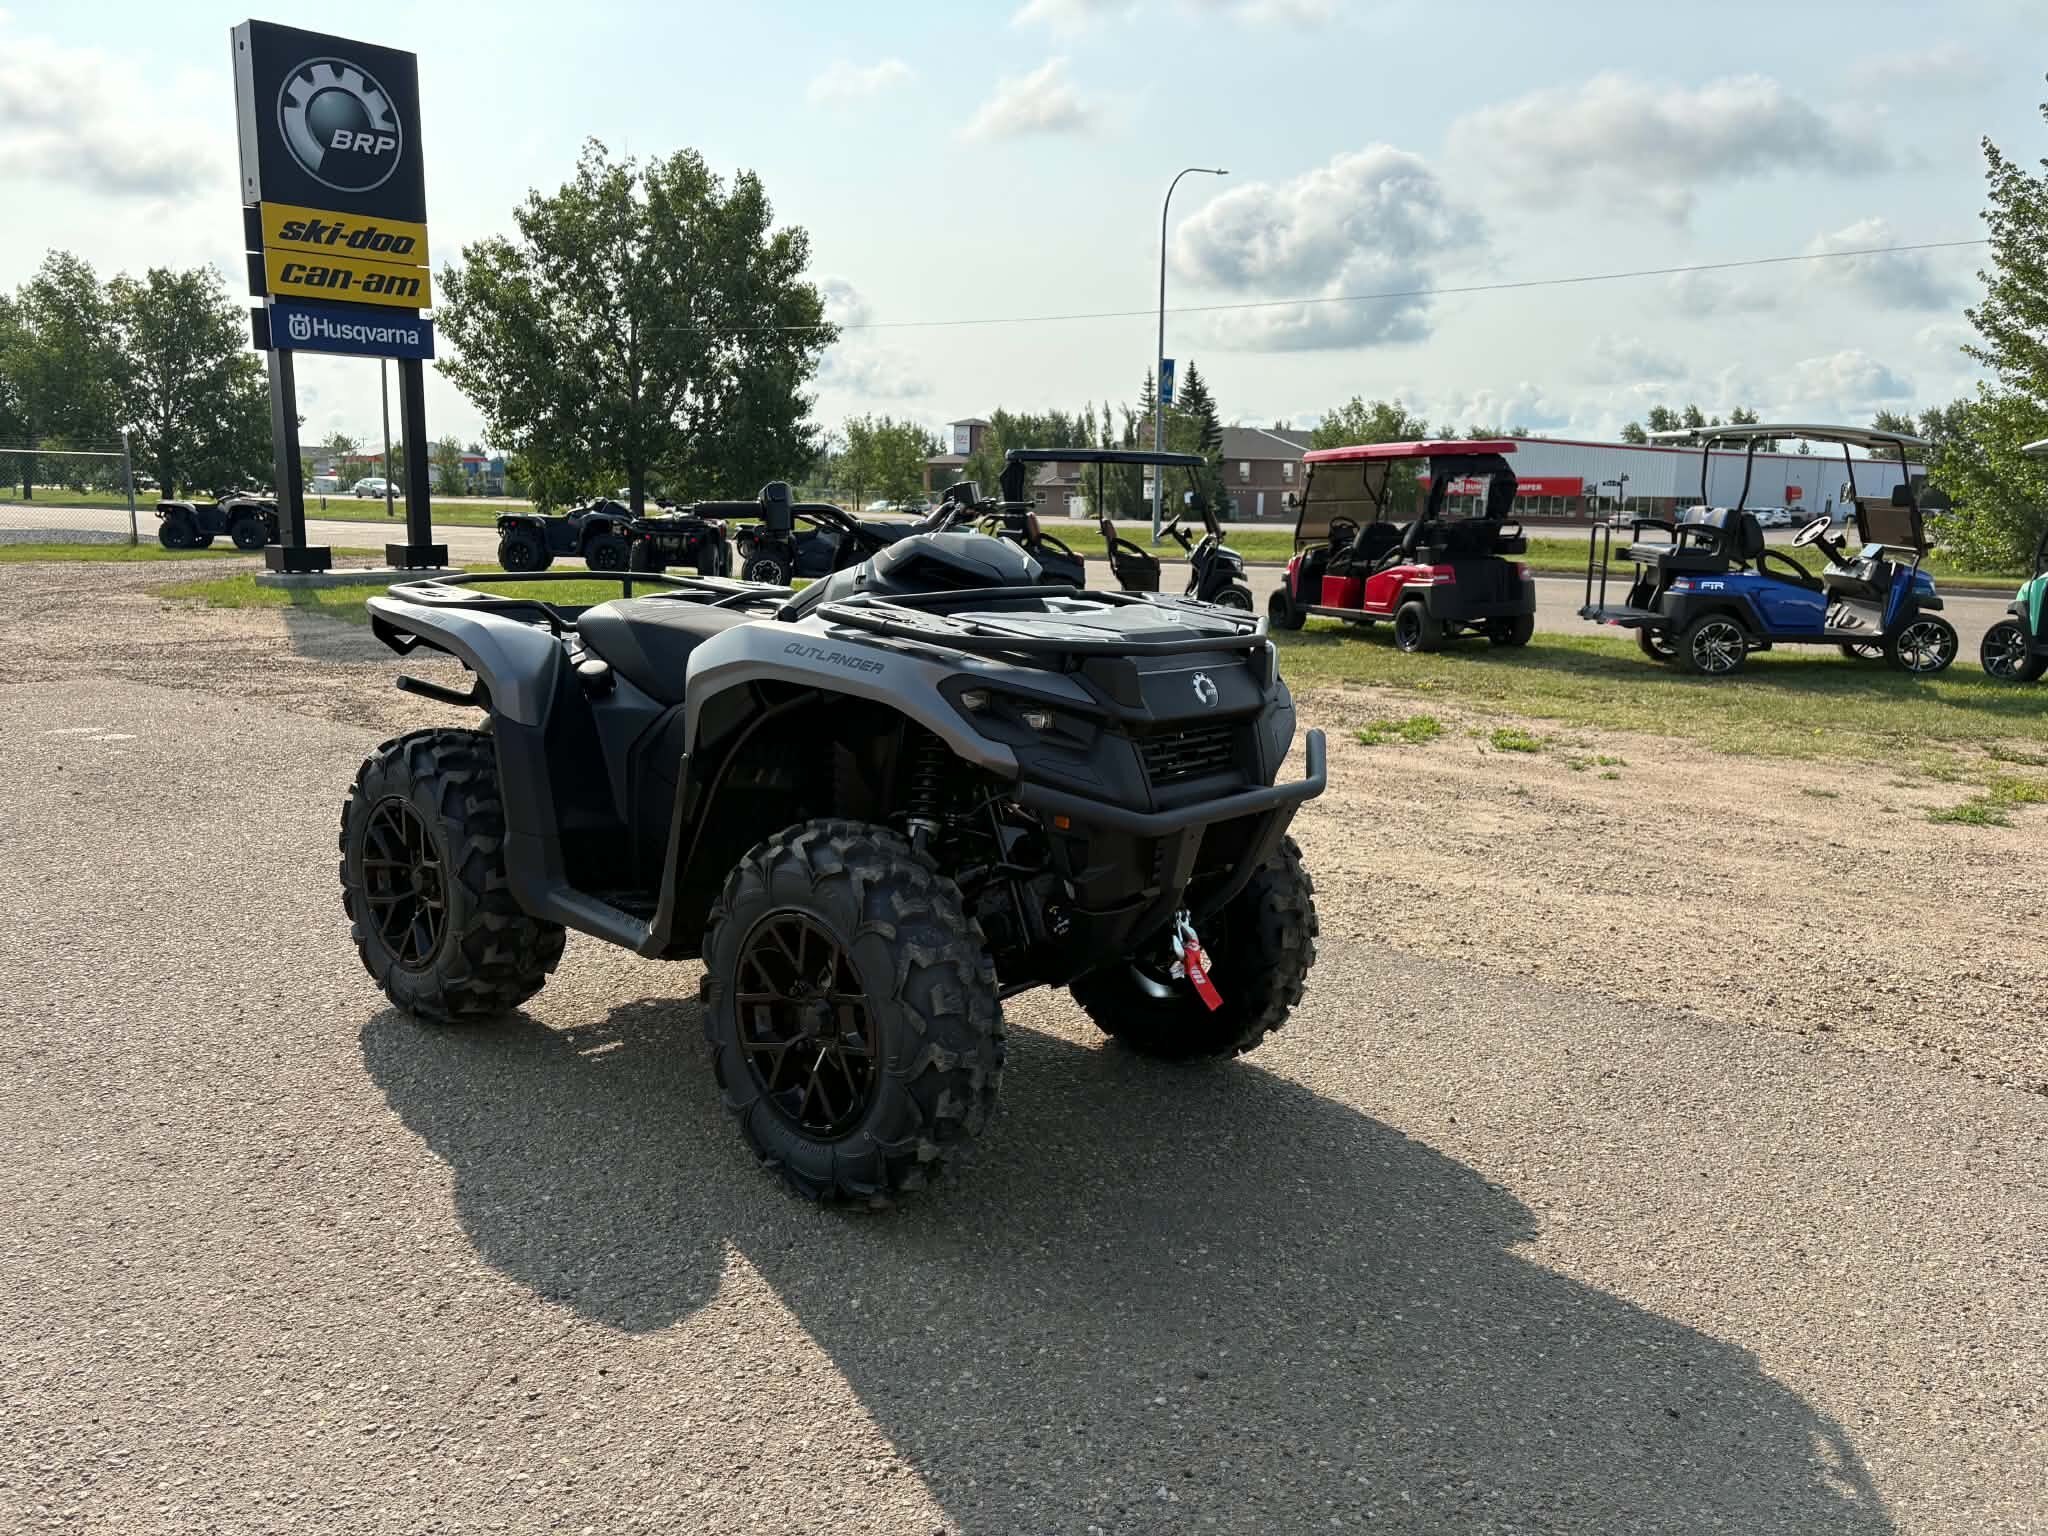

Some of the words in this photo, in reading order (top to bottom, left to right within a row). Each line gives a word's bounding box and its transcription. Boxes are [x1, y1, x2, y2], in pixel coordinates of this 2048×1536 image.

[330, 128, 396, 156] BRP
[278, 219, 416, 256] ski-doo
[280, 262, 421, 298] can-am
[312, 317, 419, 345] Husqvarna
[783, 642, 886, 674] OUTLANDER
